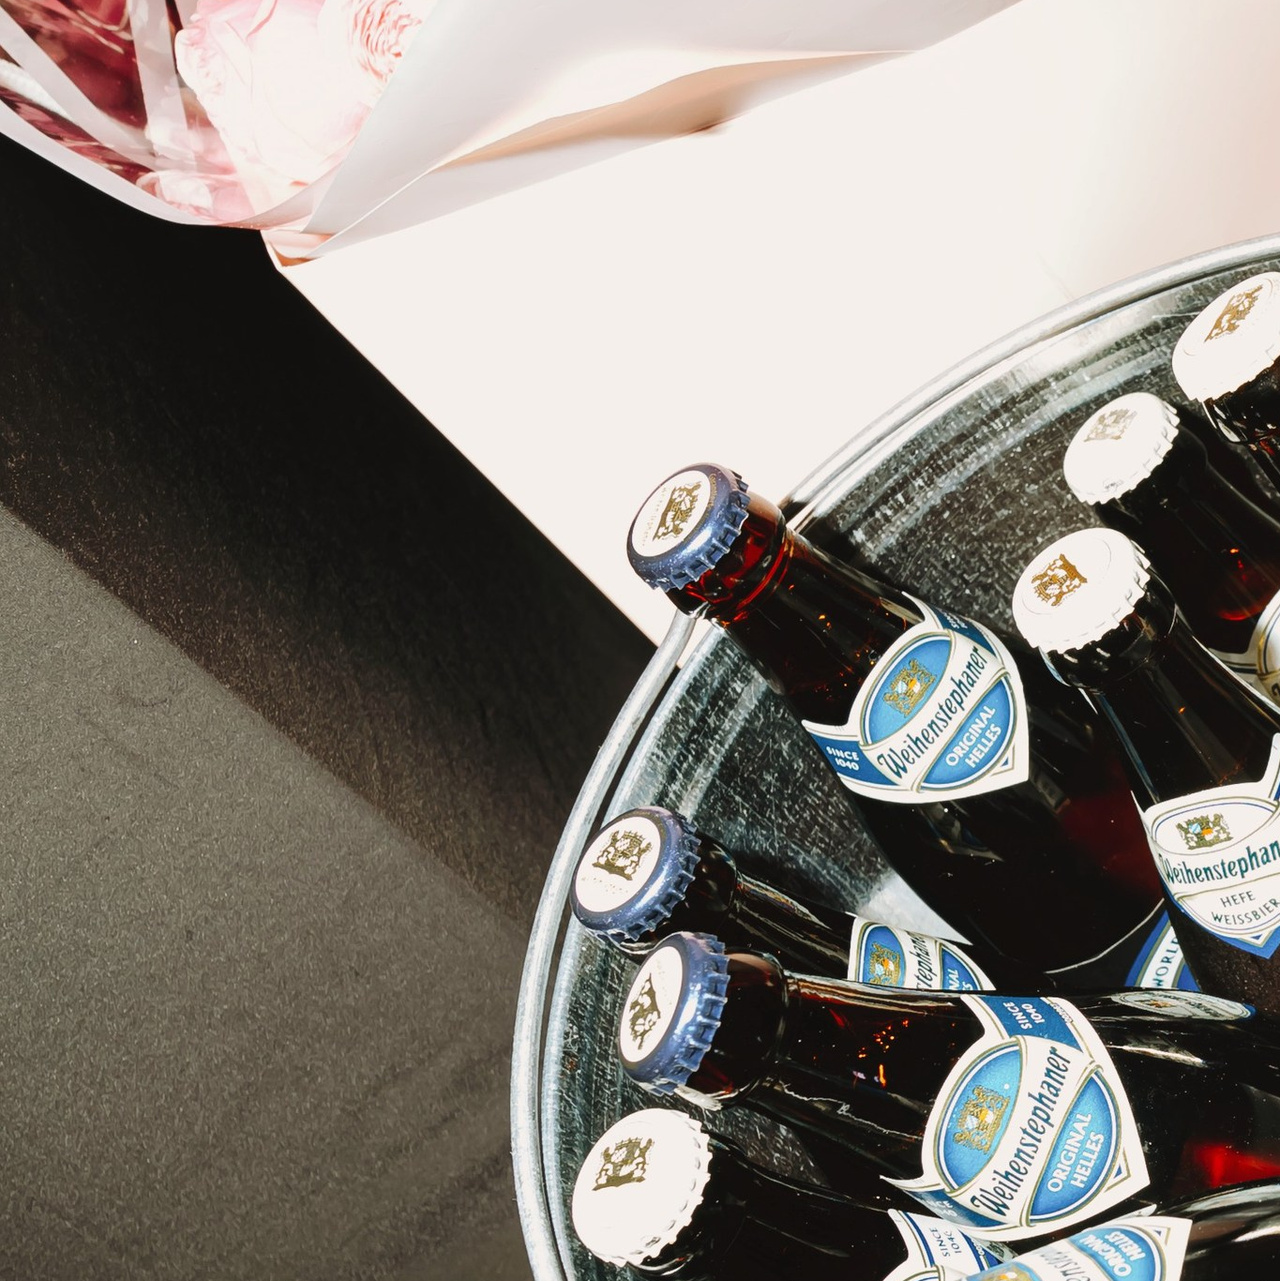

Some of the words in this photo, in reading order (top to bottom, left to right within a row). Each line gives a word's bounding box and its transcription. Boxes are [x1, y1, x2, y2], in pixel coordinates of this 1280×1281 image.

[876, 645, 988, 779] Weihenstephaner
[945, 705, 996, 767] ORIGINAL
[964, 723, 1002, 768] HELLES
[826, 746, 860, 761] SINCE
[834, 757, 860, 771] 1040
[1219, 890, 1255, 908] HEFE
[1003, 1001, 1033, 1030] SINCE
[1022, 1003, 1045, 1024] 1040
[970, 1046, 1071, 1217] Weihenstephaner
[1046, 1112, 1092, 1193] ORIGINAL
[1070, 1132, 1105, 1188] HELLES
[929, 1227, 951, 1257] SINCE
[1104, 1231, 1146, 1261] HELLES
